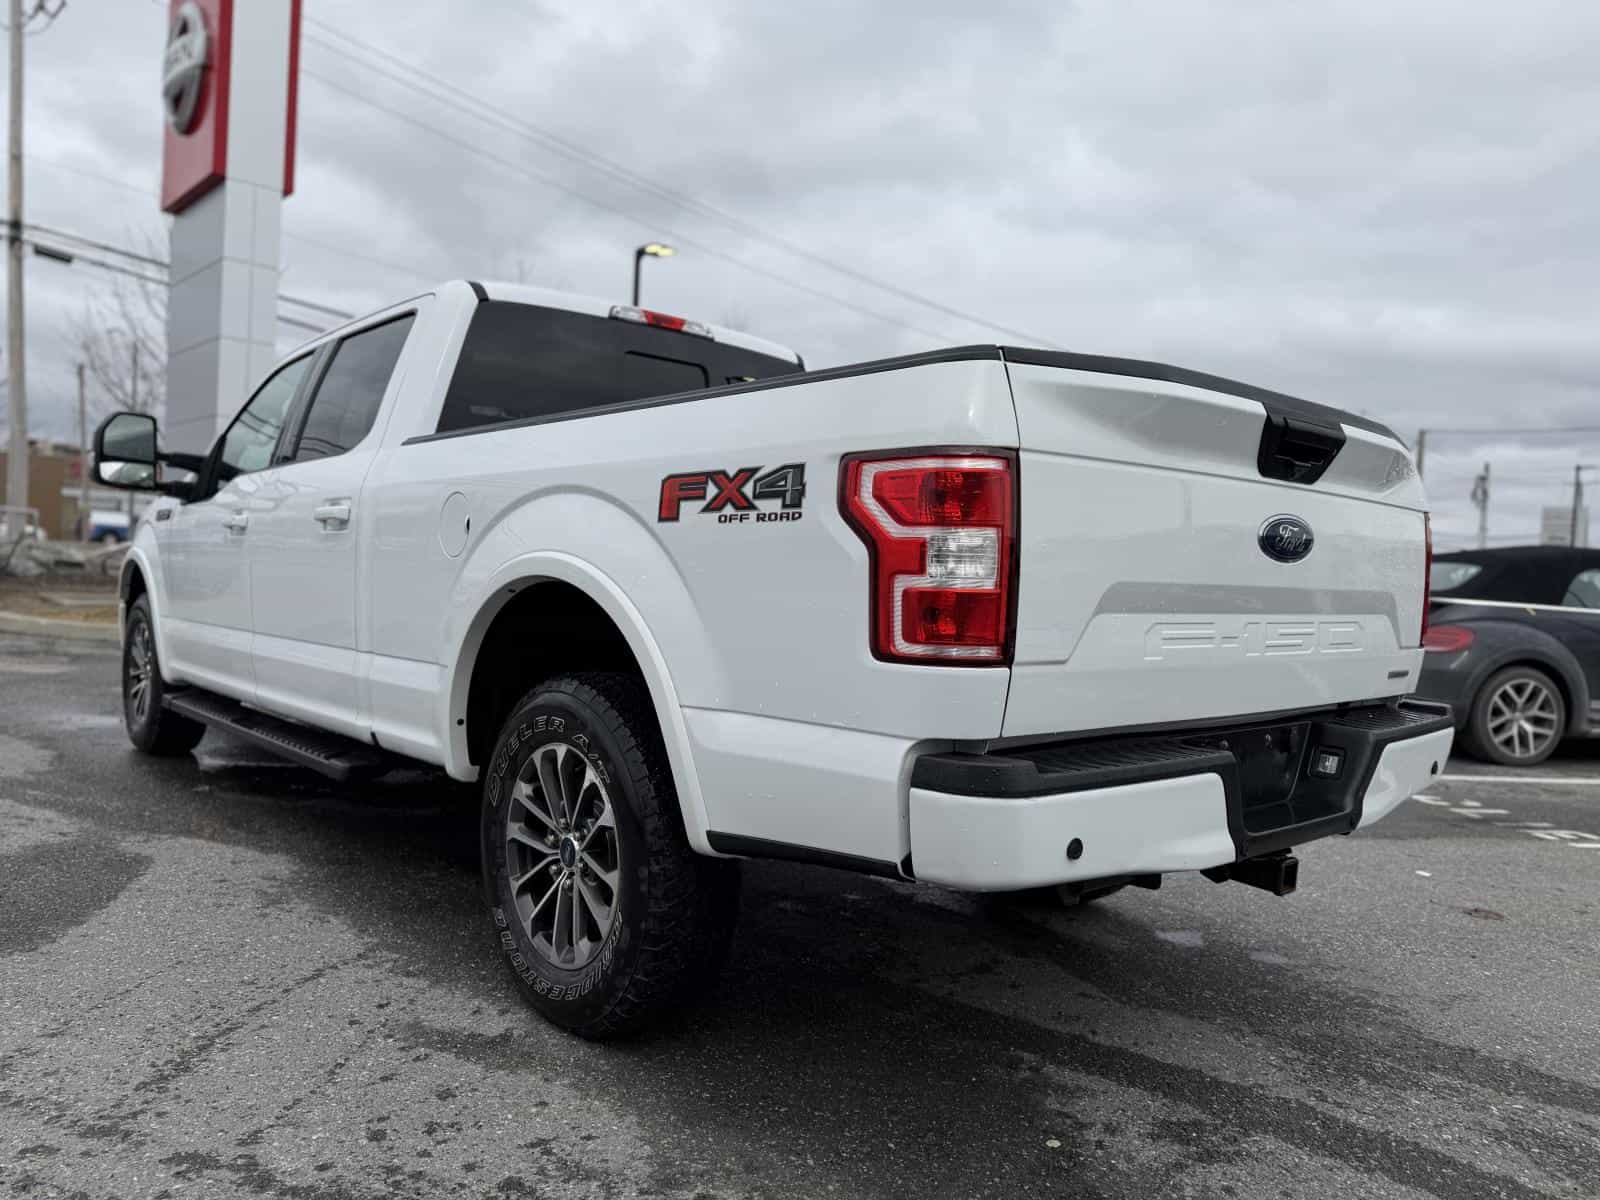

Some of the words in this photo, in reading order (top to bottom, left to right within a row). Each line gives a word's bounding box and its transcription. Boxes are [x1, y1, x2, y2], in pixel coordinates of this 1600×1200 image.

[658, 462, 806, 522] FX4
[718, 513, 750, 523] OFF
[756, 511, 802, 522] ROAD
[1143, 621, 1364, 661] F-150
[488, 715, 565, 807] DUELER
[495, 905, 623, 1000] BRIDGESTONE
